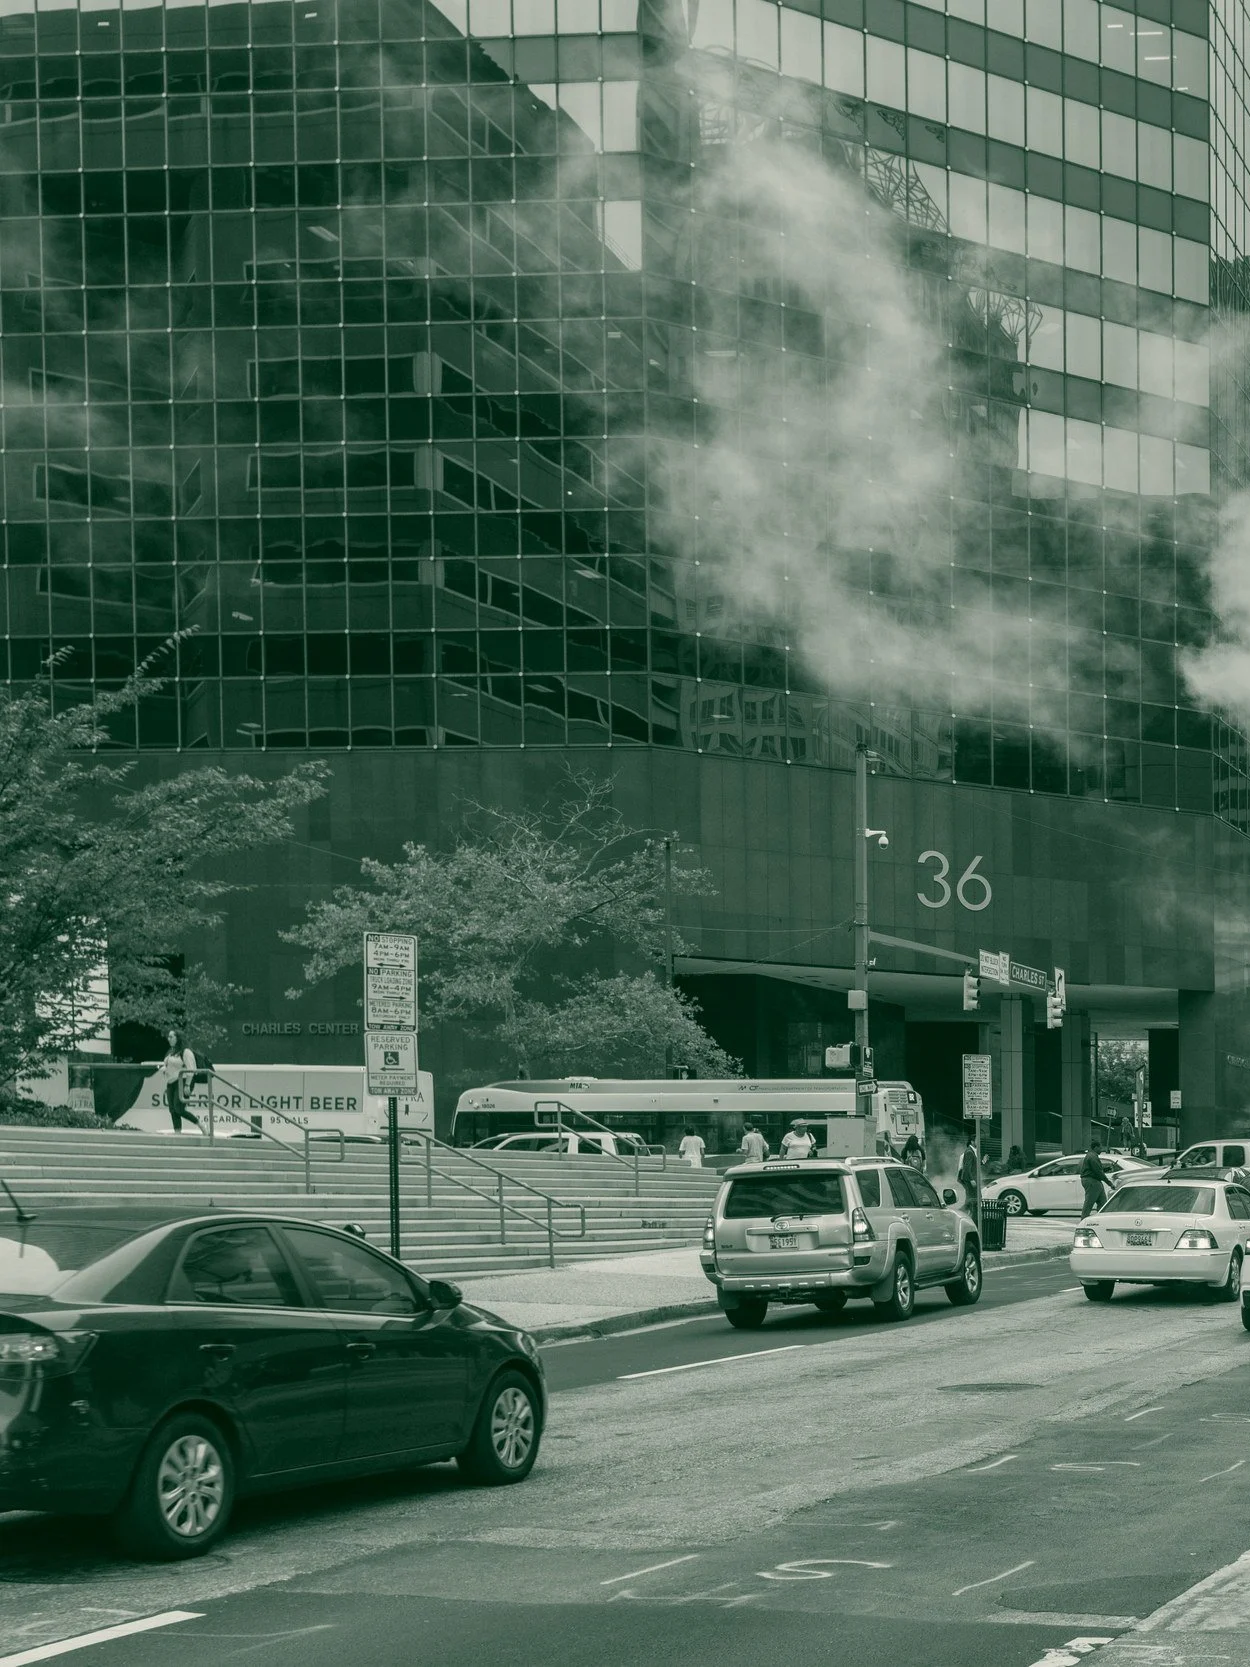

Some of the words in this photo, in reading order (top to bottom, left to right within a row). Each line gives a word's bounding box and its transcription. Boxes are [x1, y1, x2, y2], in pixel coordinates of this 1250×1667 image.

[917, 850, 992, 911] 36
[381, 937, 412, 945] STOPPING
[373, 950, 409, 958] 4PM-6PM
[1012, 966, 1038, 985] CHARLES
[1039, 975, 1044, 985] ST
[371, 1007, 411, 1015] 8AM-6PM
[242, 1022, 301, 1035] CHARLES
[309, 1022, 358, 1034] CENTER
[250, 1096, 302, 1109] LIGHT
[310, 1096, 357, 1110] BEER
[270, 1116, 281, 1124] 95
